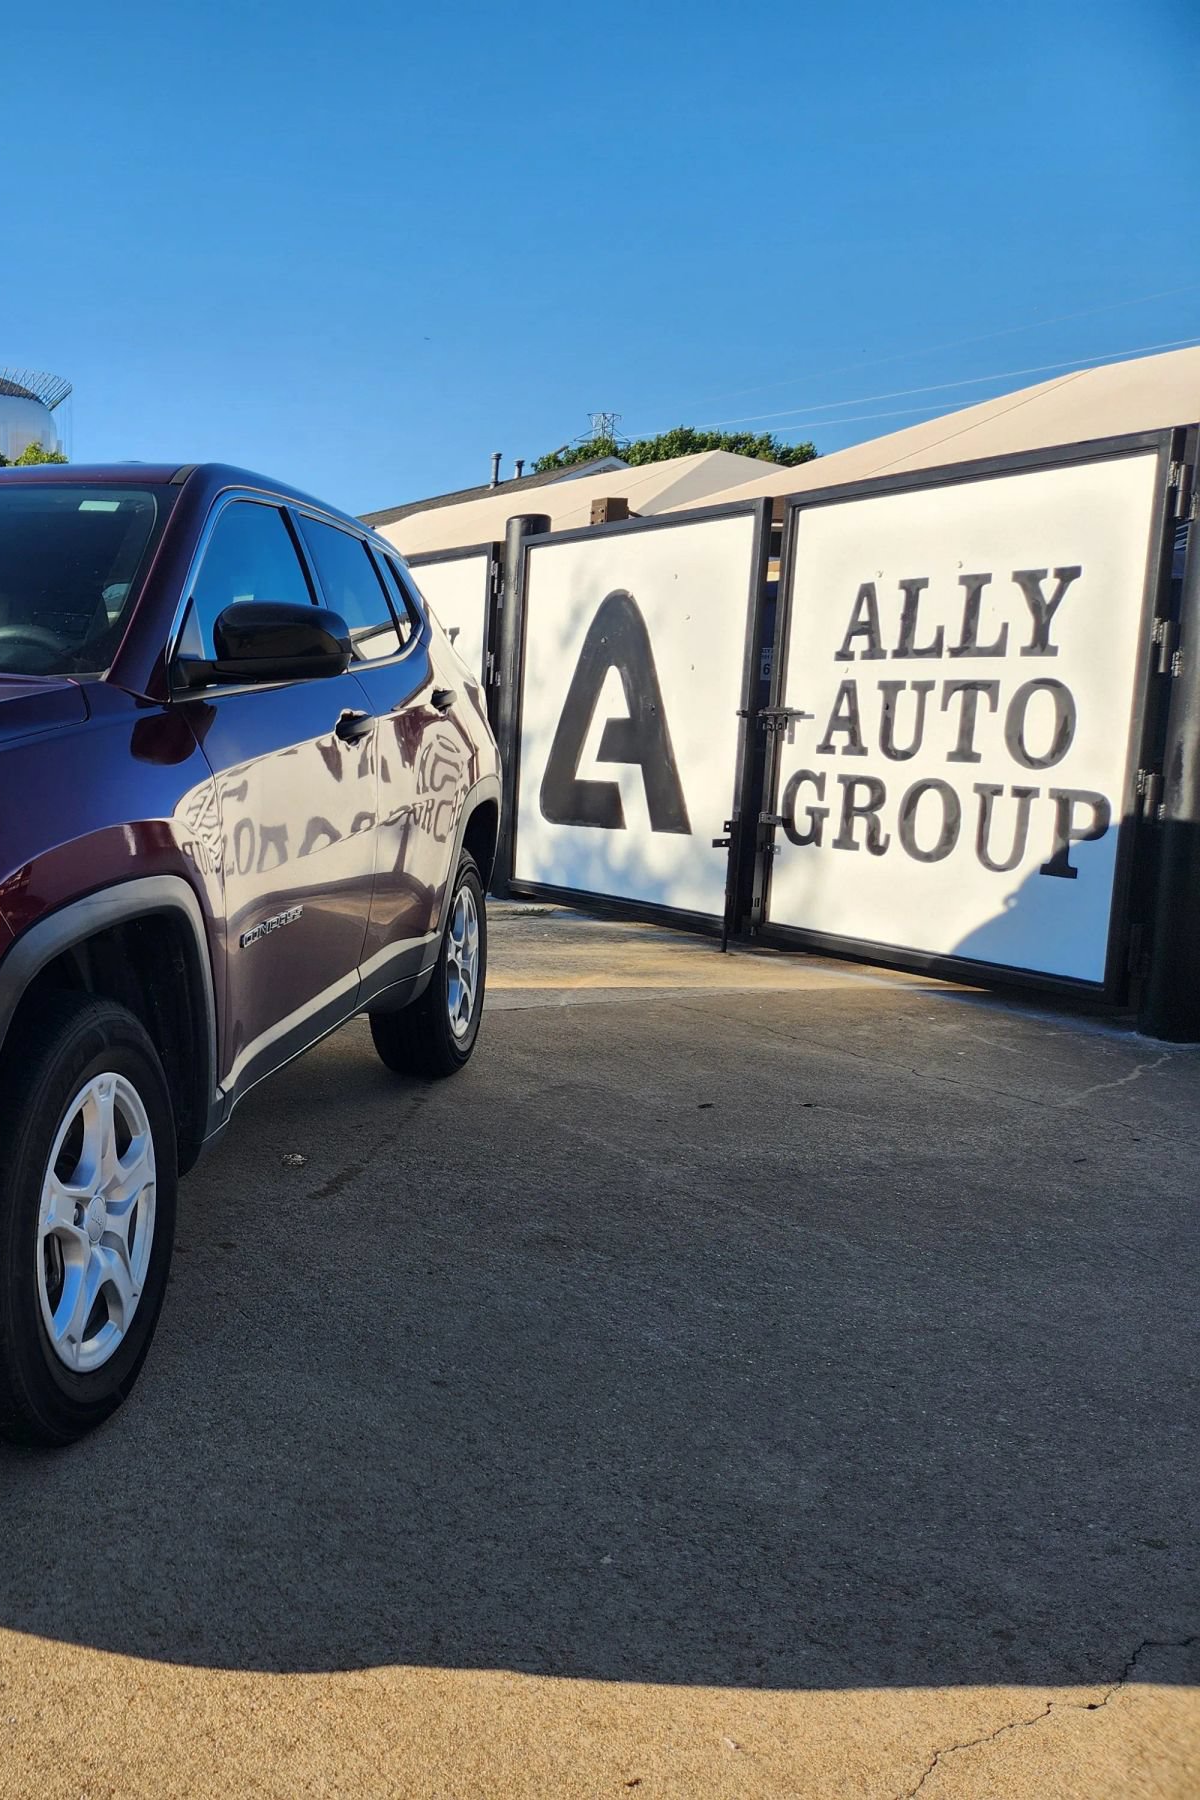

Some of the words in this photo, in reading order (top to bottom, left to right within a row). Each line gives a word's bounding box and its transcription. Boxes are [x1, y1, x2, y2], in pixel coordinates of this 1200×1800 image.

[834, 566, 1082, 661] ALLY
[816, 678, 1077, 770] AUTO
[782, 769, 1111, 879] GROUP
[241, 905, 304, 948] COMPASS
